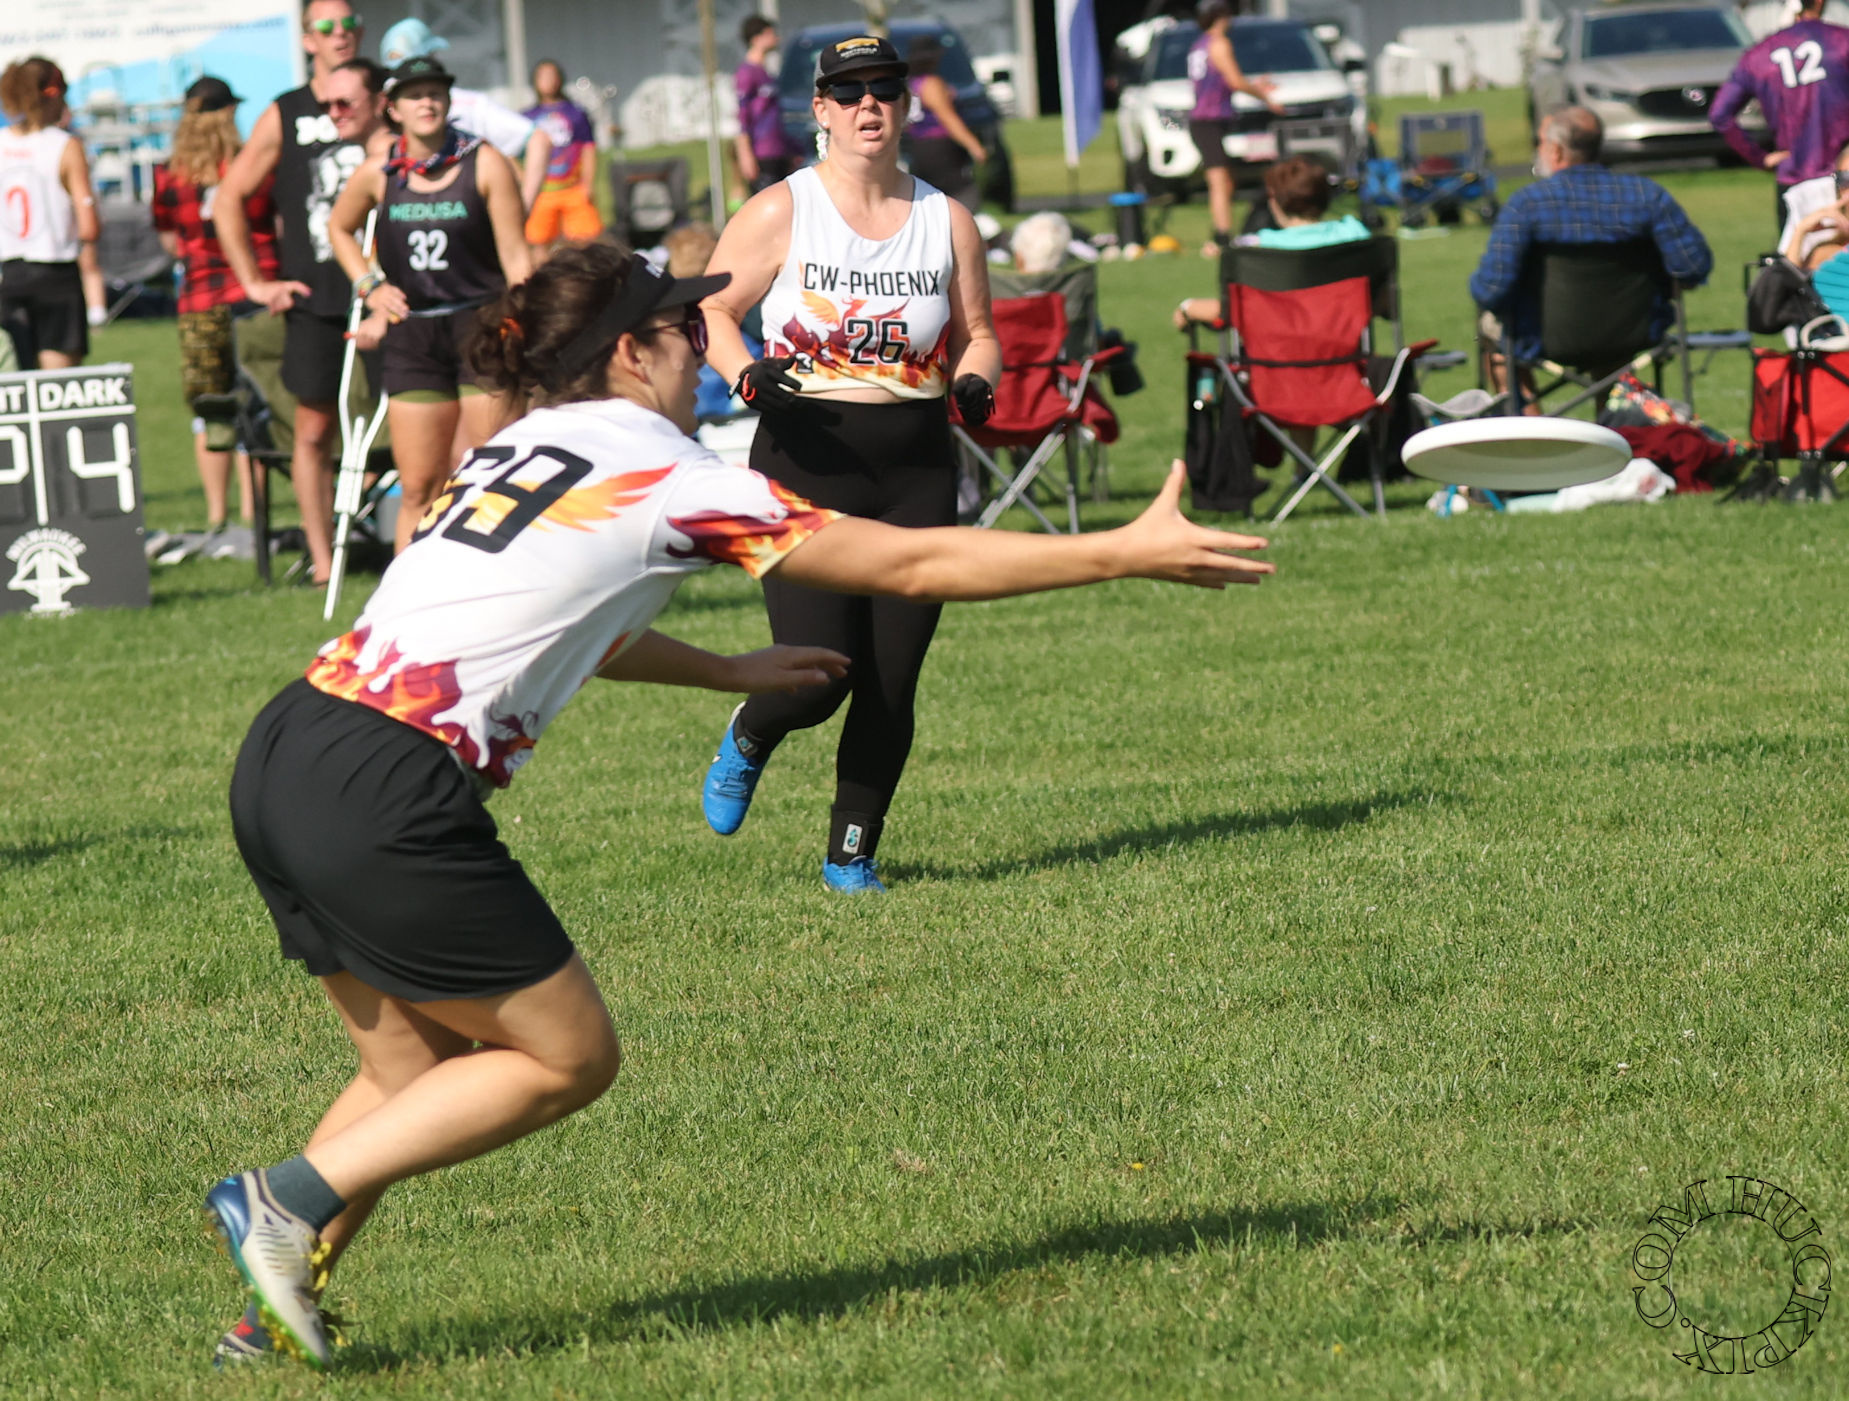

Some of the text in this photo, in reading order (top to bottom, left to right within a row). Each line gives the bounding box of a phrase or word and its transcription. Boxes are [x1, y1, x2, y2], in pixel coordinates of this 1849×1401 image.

[1770, 40, 1826, 88] 12
[389, 201, 468, 221] MEDUSA
[408, 228, 449, 271] 32
[804, 262, 940, 296] CW-PHOENIX
[846, 318, 910, 365] 26
[39, 378, 127, 411] DARK
[66, 422, 135, 513] 4
